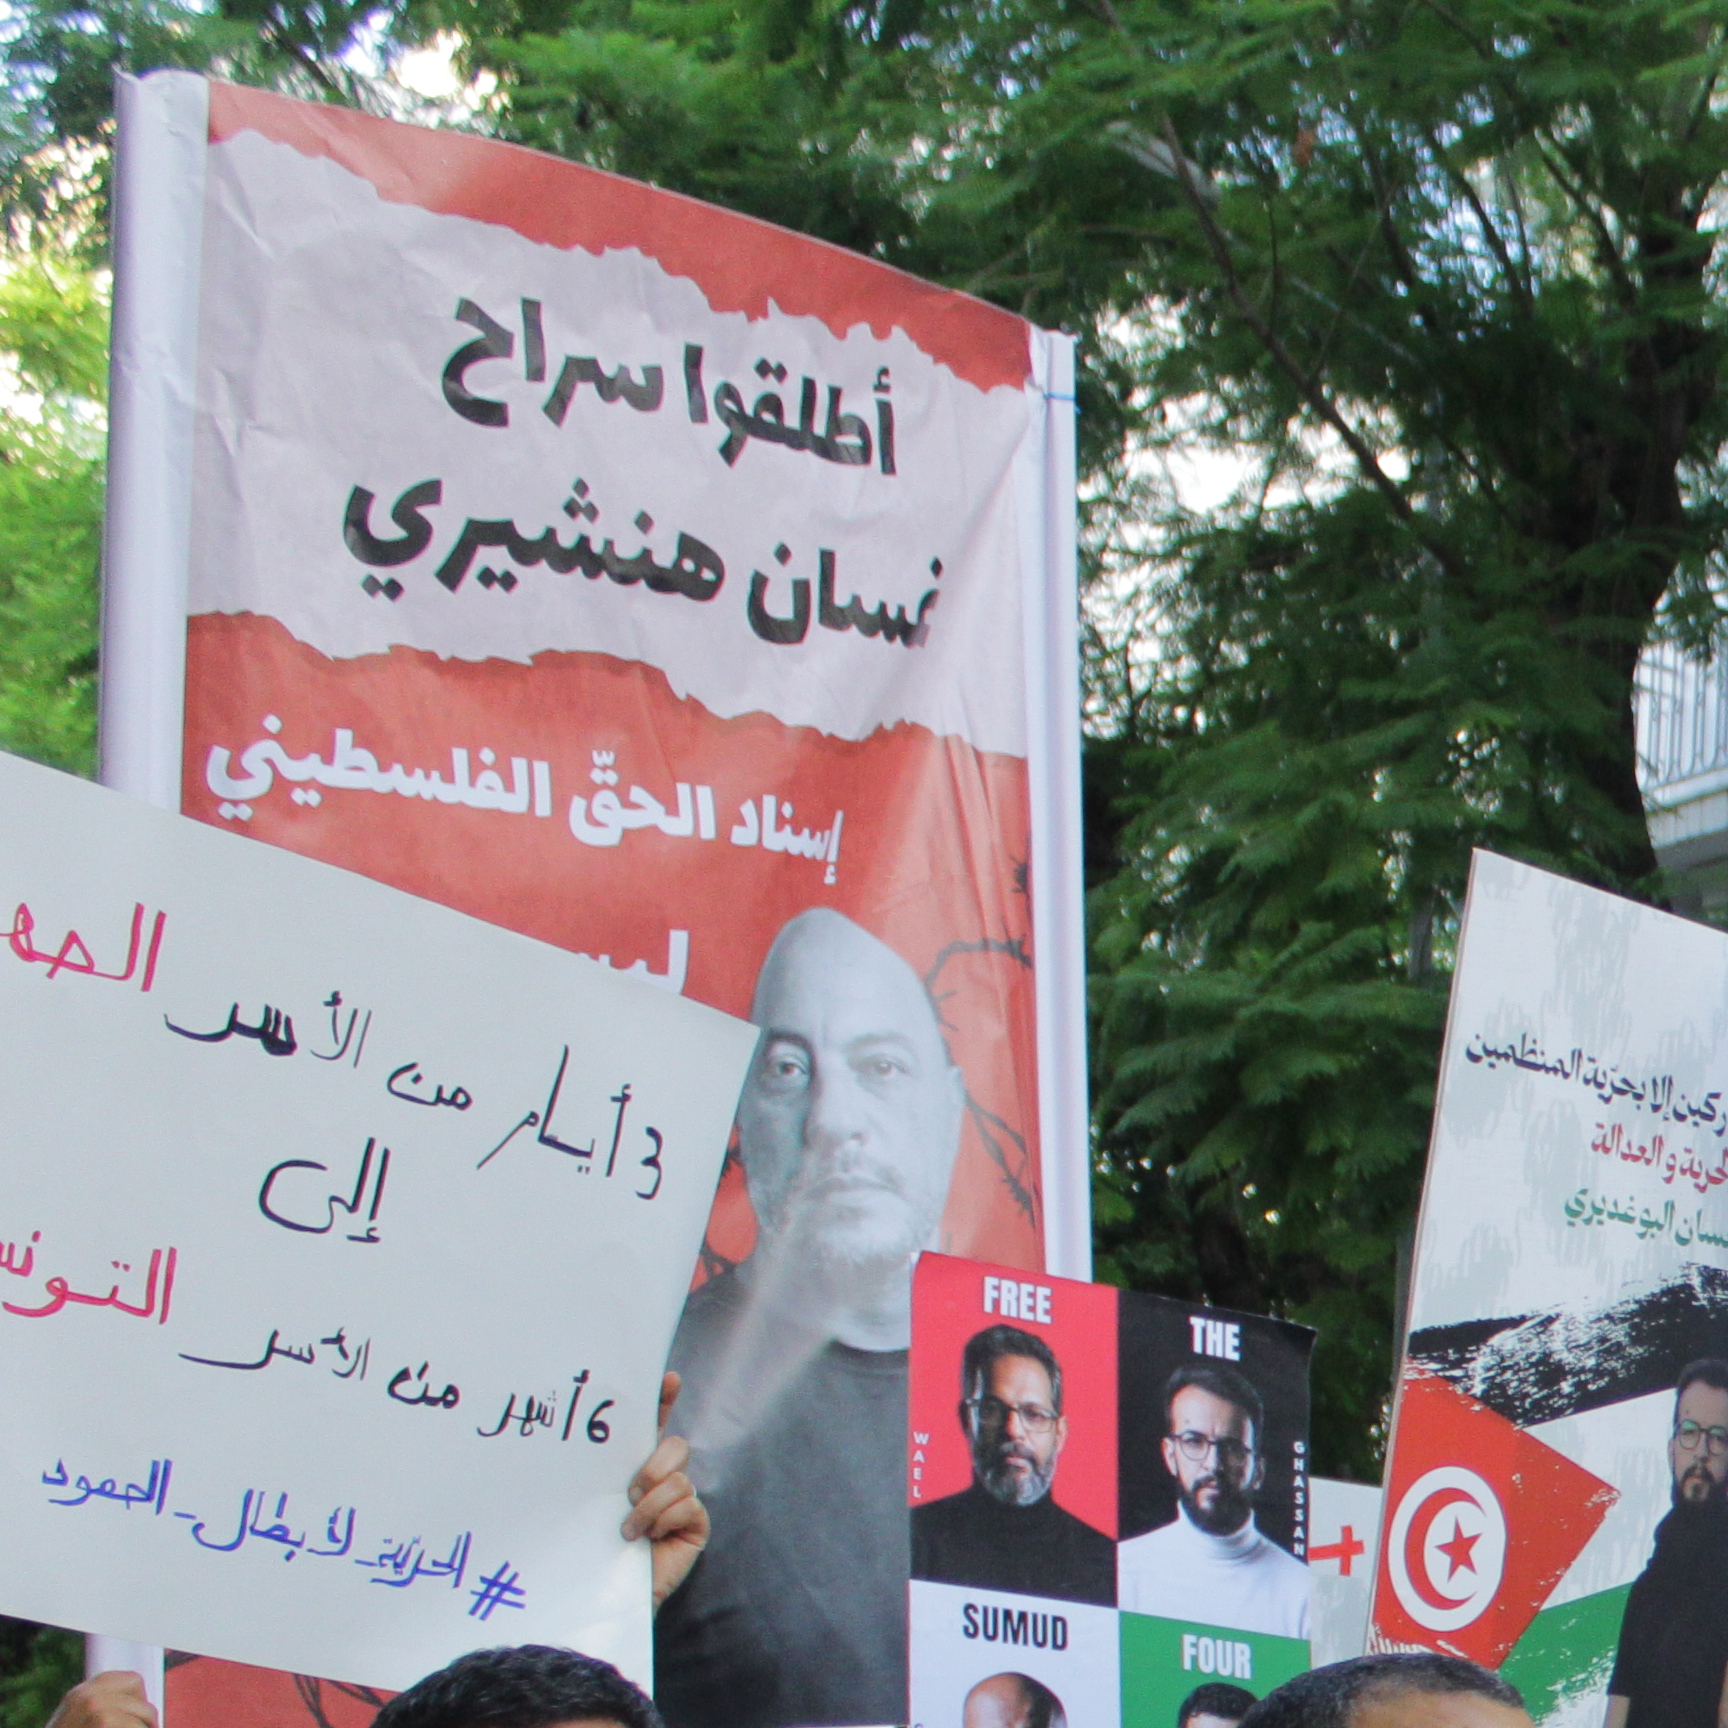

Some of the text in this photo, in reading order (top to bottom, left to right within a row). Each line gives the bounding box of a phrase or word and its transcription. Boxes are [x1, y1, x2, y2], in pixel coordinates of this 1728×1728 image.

[441, 298, 898, 475] أطلقوا سراح
[343, 476, 727, 602] هنشيري
[205, 716, 551, 819] الفلسطيني
[731, 795, 844, 885] إسناد
[387, 1062, 473, 1111] من
[1465, 1032, 1583, 1081] المنظمين
[476, 1044, 632, 1178] أيام
[1651, 1075, 1673, 1122] إلا
[1591, 1123, 1664, 1166] العدالة
[1662, 1153, 1676, 1184] و
[258, 1136, 390, 1244] إلى
[983, 1276, 1240, 1362] FREE THE
[387, 1362, 460, 1408] من
[587, 1400, 615, 1443] 6
[913, 1432, 929, 1498] WAEL
[1293, 1440, 1306, 1556] GHASSAN
[962, 1603, 1251, 1681] SUMUD FOUR
